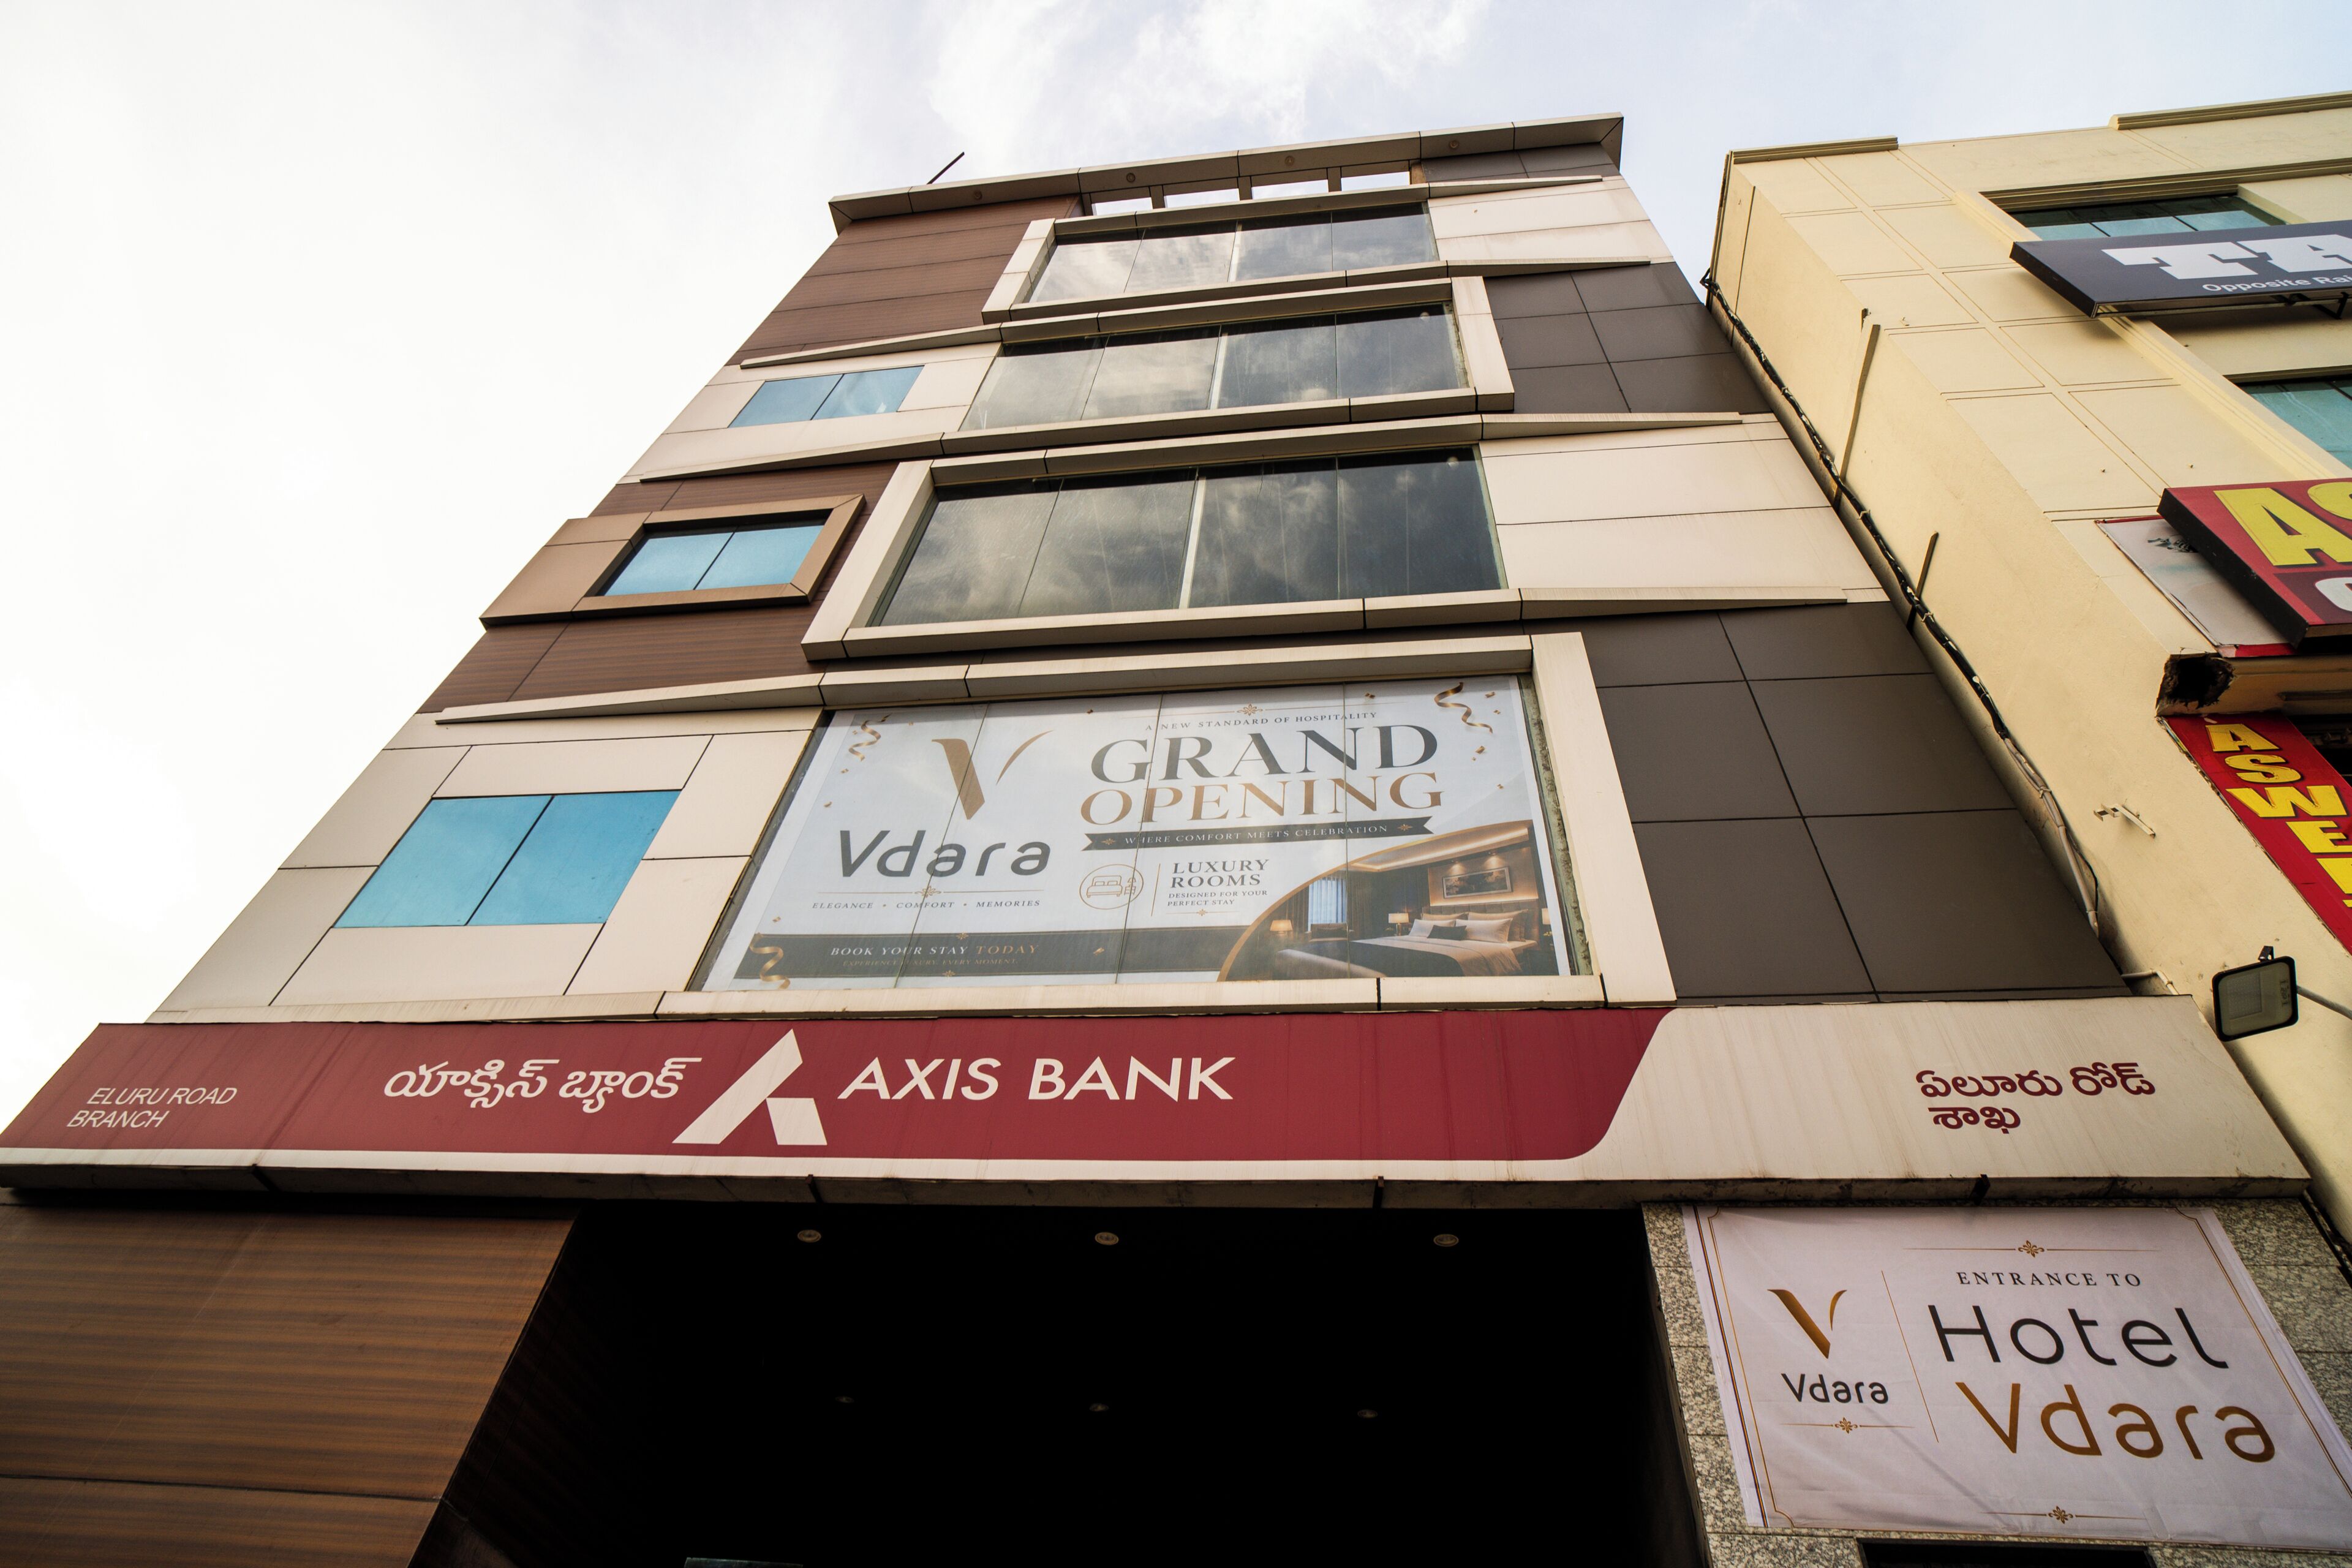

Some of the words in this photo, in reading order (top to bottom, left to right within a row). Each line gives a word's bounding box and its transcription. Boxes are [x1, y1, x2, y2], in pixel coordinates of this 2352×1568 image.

[2202, 277, 2312, 292] Opposite
[1198, 718, 1268, 728] STANDARD
[1295, 712, 1377, 722] HOSPITALITY
[1091, 725, 1438, 784] GRAND
[1080, 772, 1444, 826] OPENING
[1125, 835, 1170, 844] WHERE
[1175, 832, 1242, 842] COMFORT
[1247, 830, 1290, 839] MEETS
[1295, 825, 1388, 837] CELEBRATION
[839, 830, 1051, 878] Vdara
[1173, 859, 1270, 874] LUXURY
[1170, 873, 1261, 888] ROOMS
[831, 947, 873, 956] BOOK
[881, 946, 922, 956] YOUR
[929, 946, 968, 955] STAY
[976, 944, 1039, 955] TODAY
[837, 1056, 1001, 1101] AXIS
[1028, 1055, 1236, 1102] BANK
[1915, 1069, 2064, 1098] ఏలూరు
[2069, 1061, 2156, 1096] రోడ్
[87, 1087, 169, 1105] ELURU
[169, 1087, 238, 1104] ROAD
[67, 1110, 169, 1128] BRANCH
[1956, 1271, 2098, 1287] ENTRANCE
[2107, 1272, 2141, 1287] TO
[1927, 1305, 2230, 1369] Hotel
[1781, 1373, 1889, 1404] Vdara
[1955, 1382, 2276, 1463] Vdara
